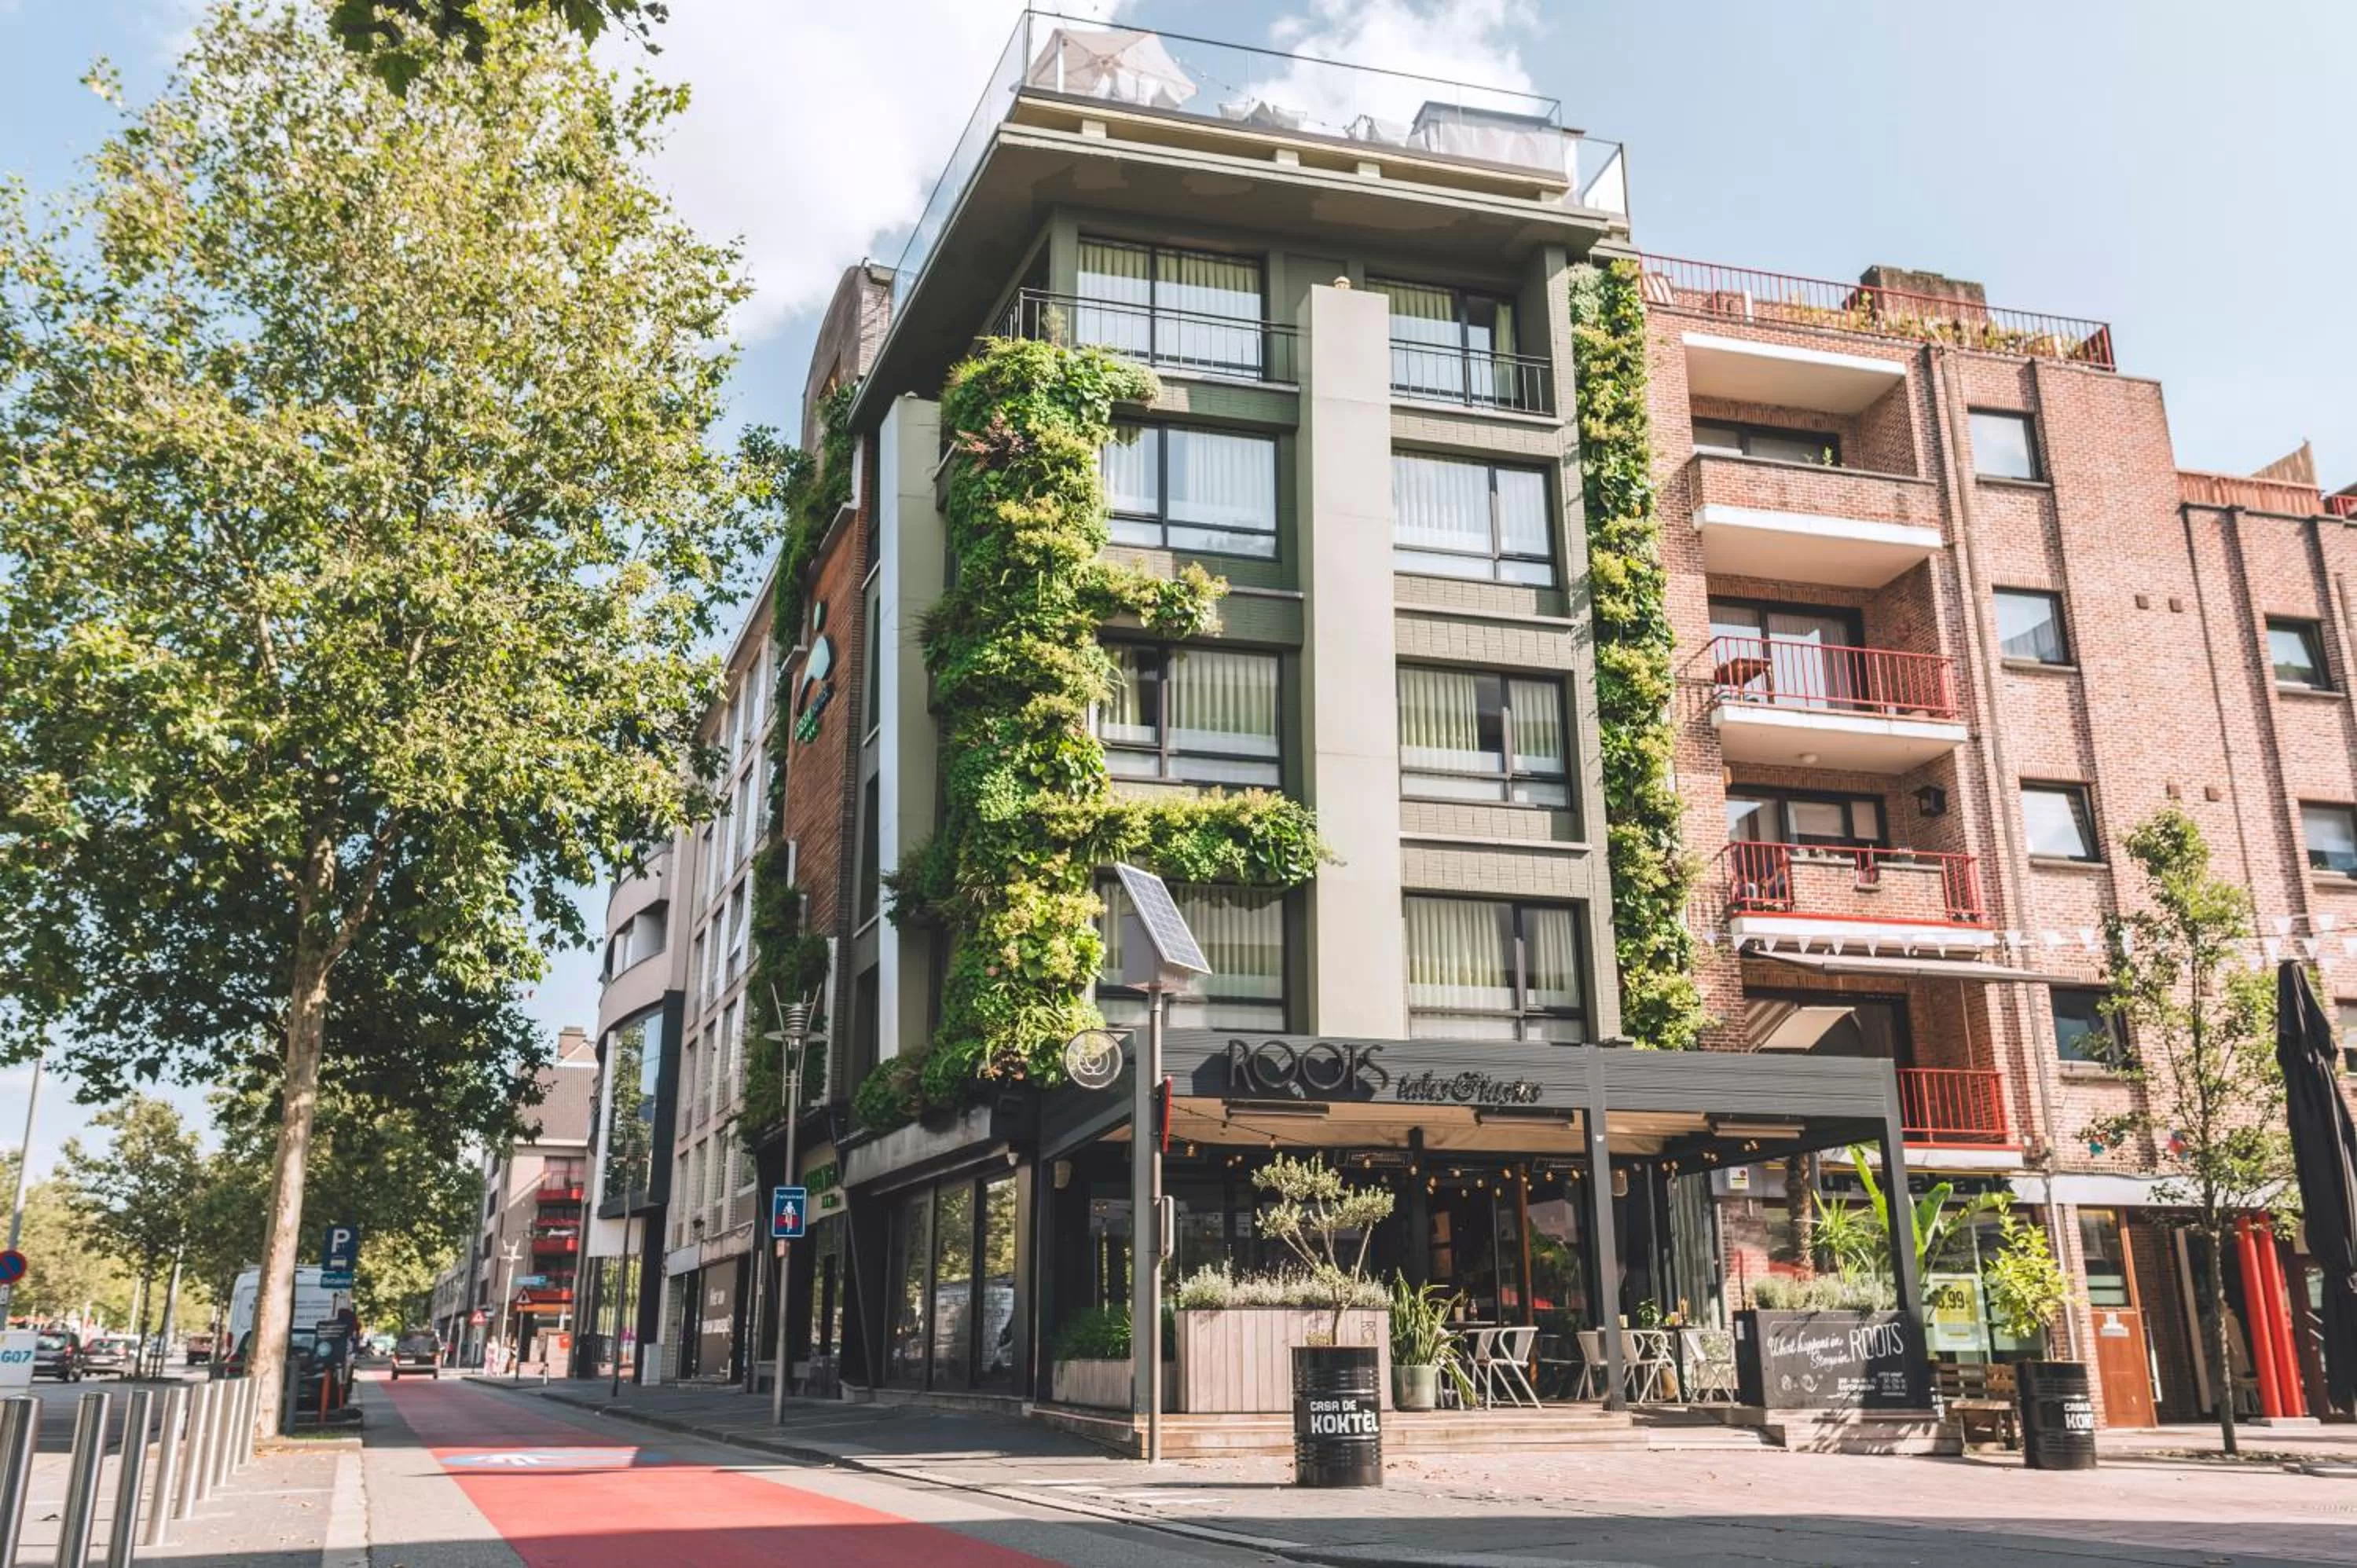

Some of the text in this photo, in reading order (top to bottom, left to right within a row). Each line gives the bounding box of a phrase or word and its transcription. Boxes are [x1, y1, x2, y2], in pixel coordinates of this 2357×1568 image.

[1228, 1039, 1390, 1093] ROOTS
[331, 1228, 351, 1254] P
[1849, 1322, 1904, 1362] ROOTS
[1310, 1399, 1357, 1412] CASA DE
[1311, 1409, 1380, 1434] KOKTÈL
